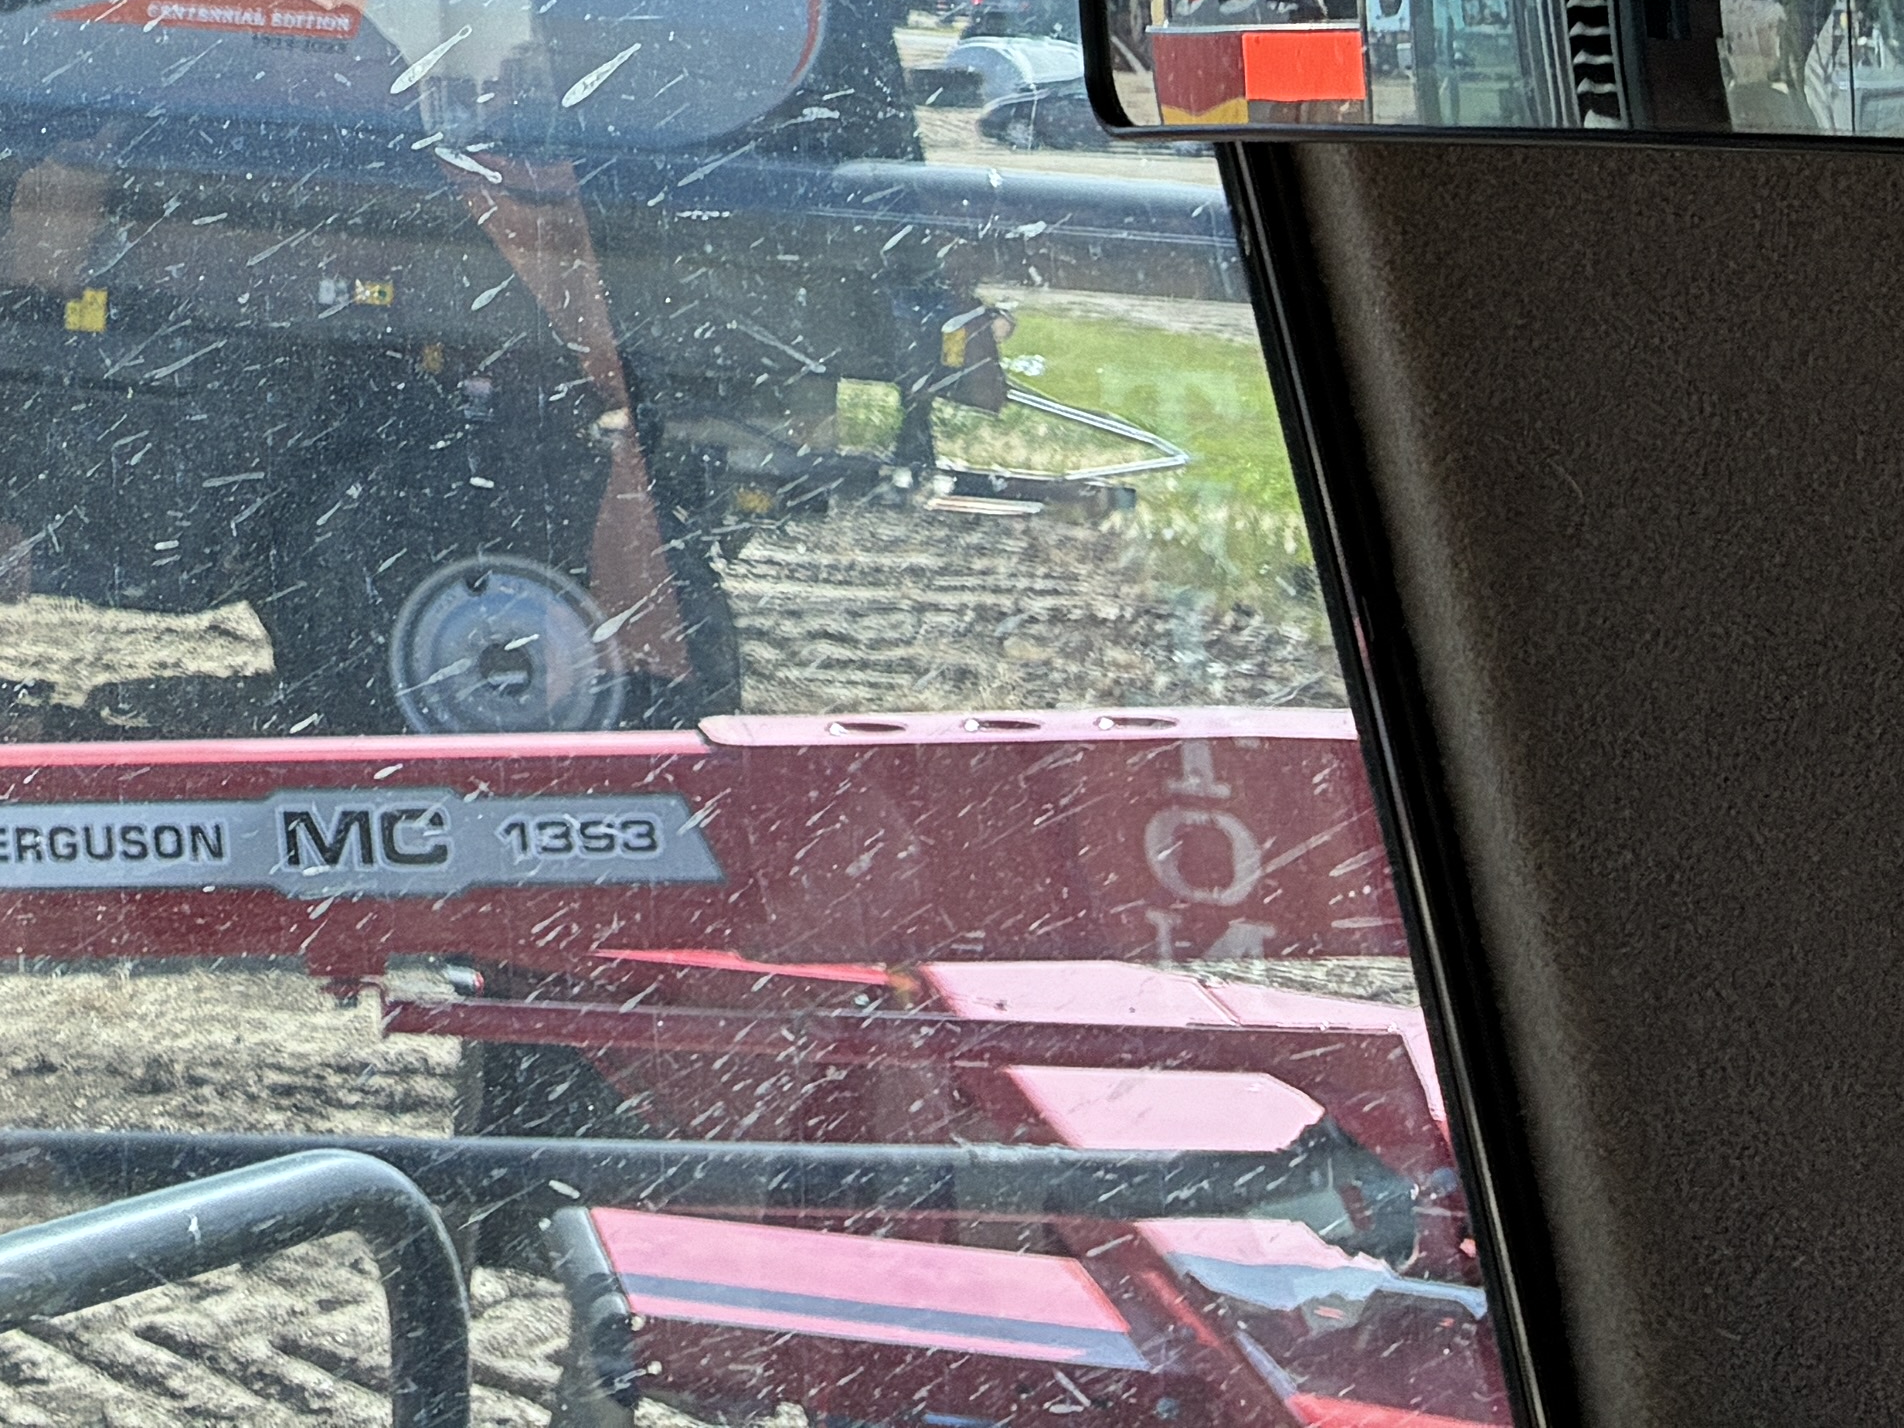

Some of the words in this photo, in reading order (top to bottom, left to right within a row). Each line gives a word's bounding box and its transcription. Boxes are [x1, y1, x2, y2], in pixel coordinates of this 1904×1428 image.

[147, 2, 265, 27] CENTENNIAL
[271, 11, 352, 33] EDITION
[279, 807, 450, 869] MC
